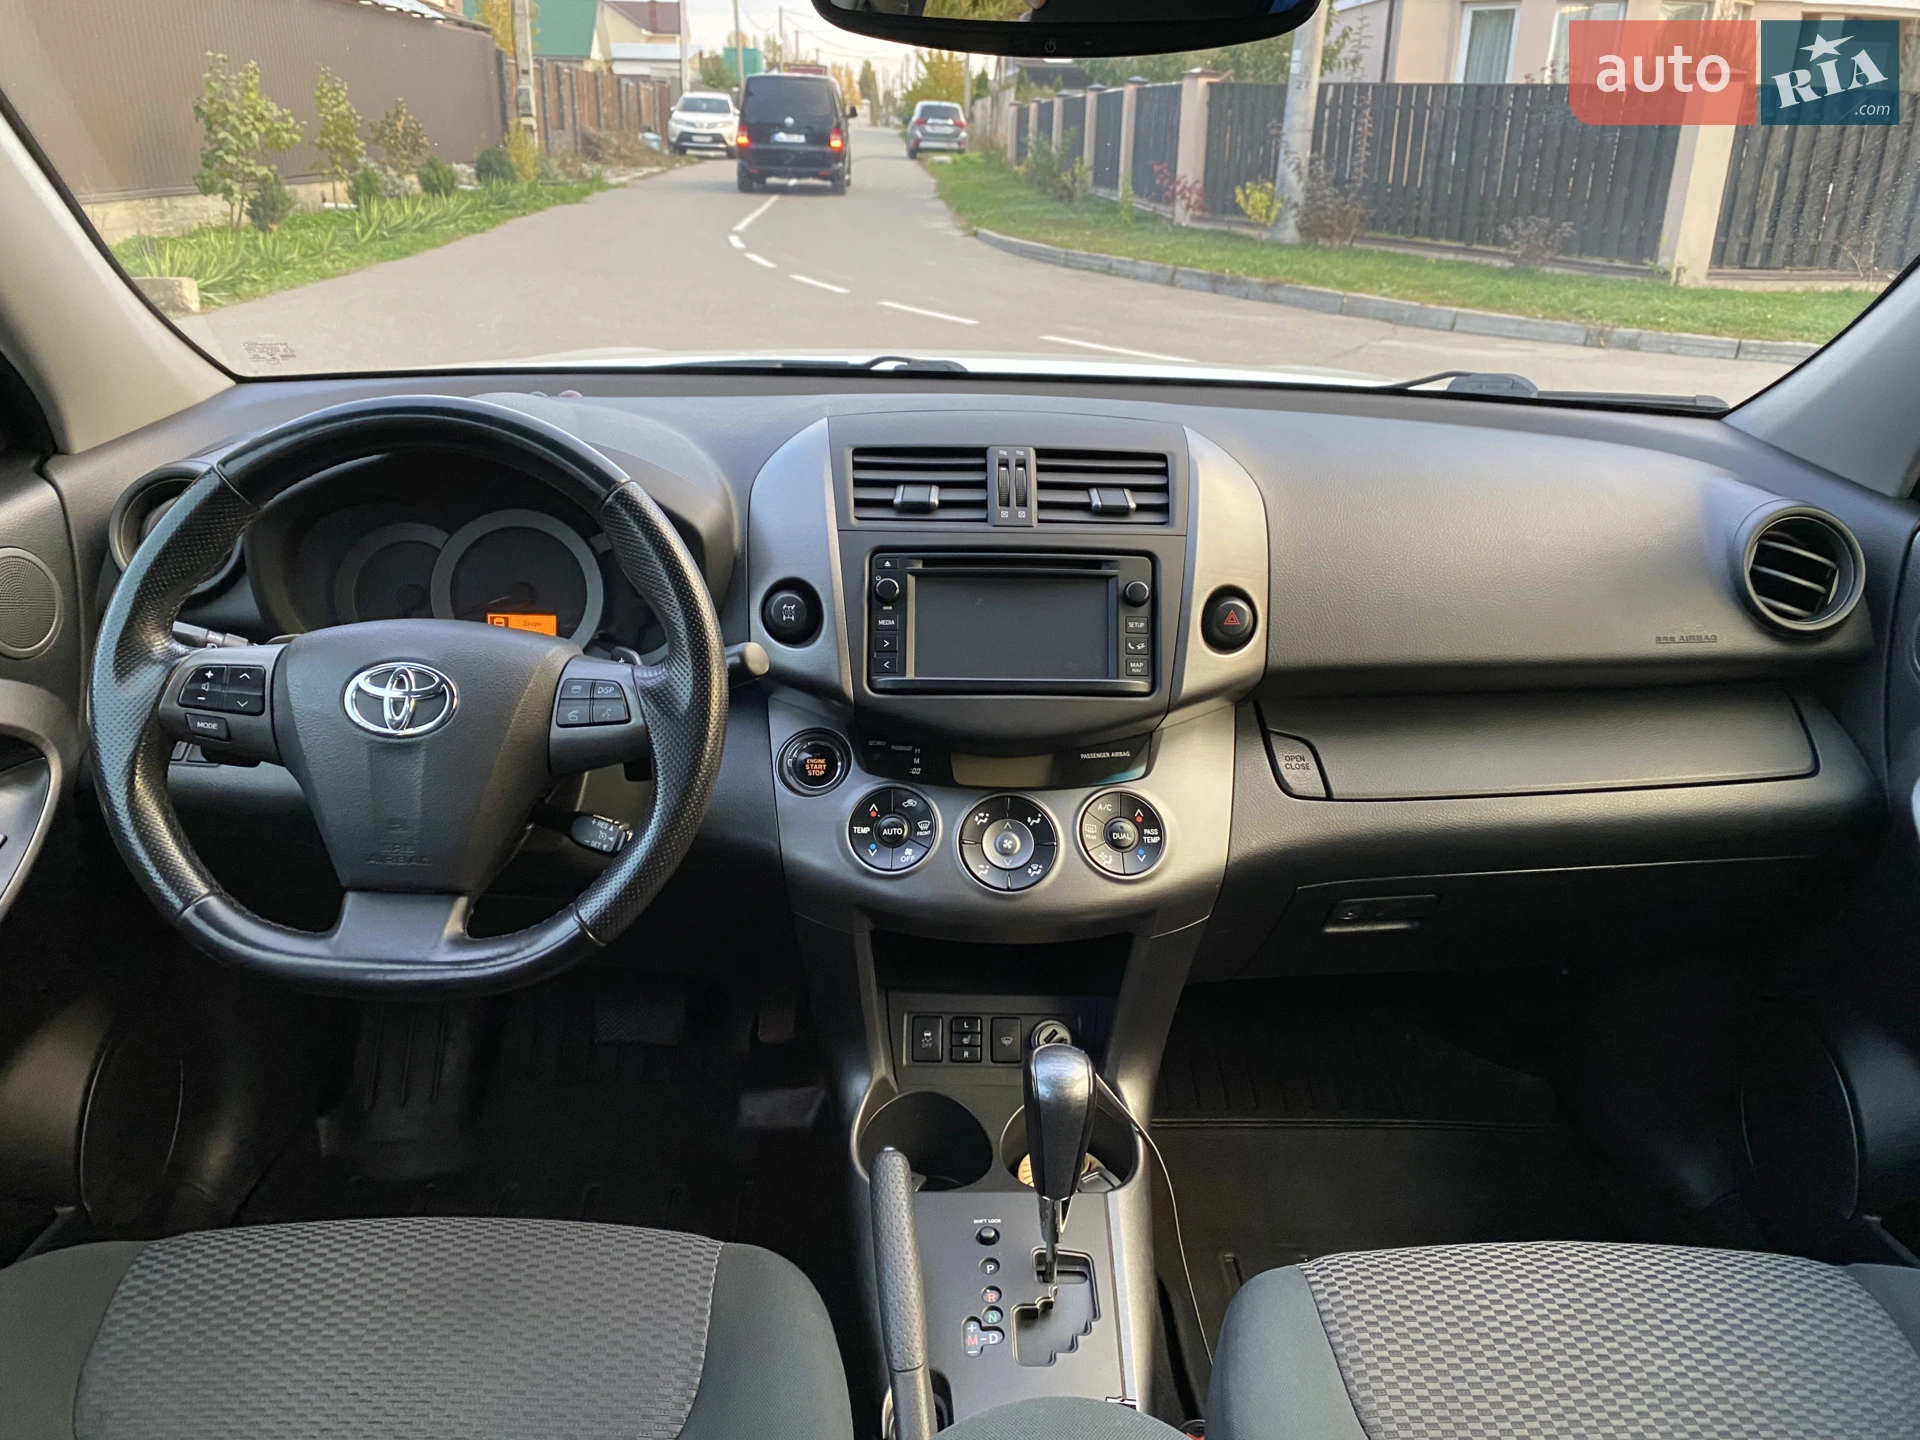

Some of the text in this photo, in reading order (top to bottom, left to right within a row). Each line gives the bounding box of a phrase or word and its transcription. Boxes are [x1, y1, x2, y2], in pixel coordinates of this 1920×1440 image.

[1128, 621, 1145, 629] SETUP
[597, 686, 615, 694] DISP
[196, 721, 218, 730] MODE
[1284, 755, 1306, 763] OPEN
[1284, 762, 1311, 771] CLOSE
[1097, 803, 1113, 811] A/C
[853, 826, 871, 834] TEMP
[882, 827, 903, 836] AUTO
[1143, 828, 1159, 836] PASS
[1112, 832, 1132, 841] DUAL
[1143, 836, 1161, 844] TEMP
[900, 855, 916, 863] OFF
[963, 1021, 969, 1029] L
[986, 1264, 995, 1274] P
[988, 1292, 996, 1302] R
[988, 1314, 997, 1323] N
[989, 1333, 998, 1344] D
